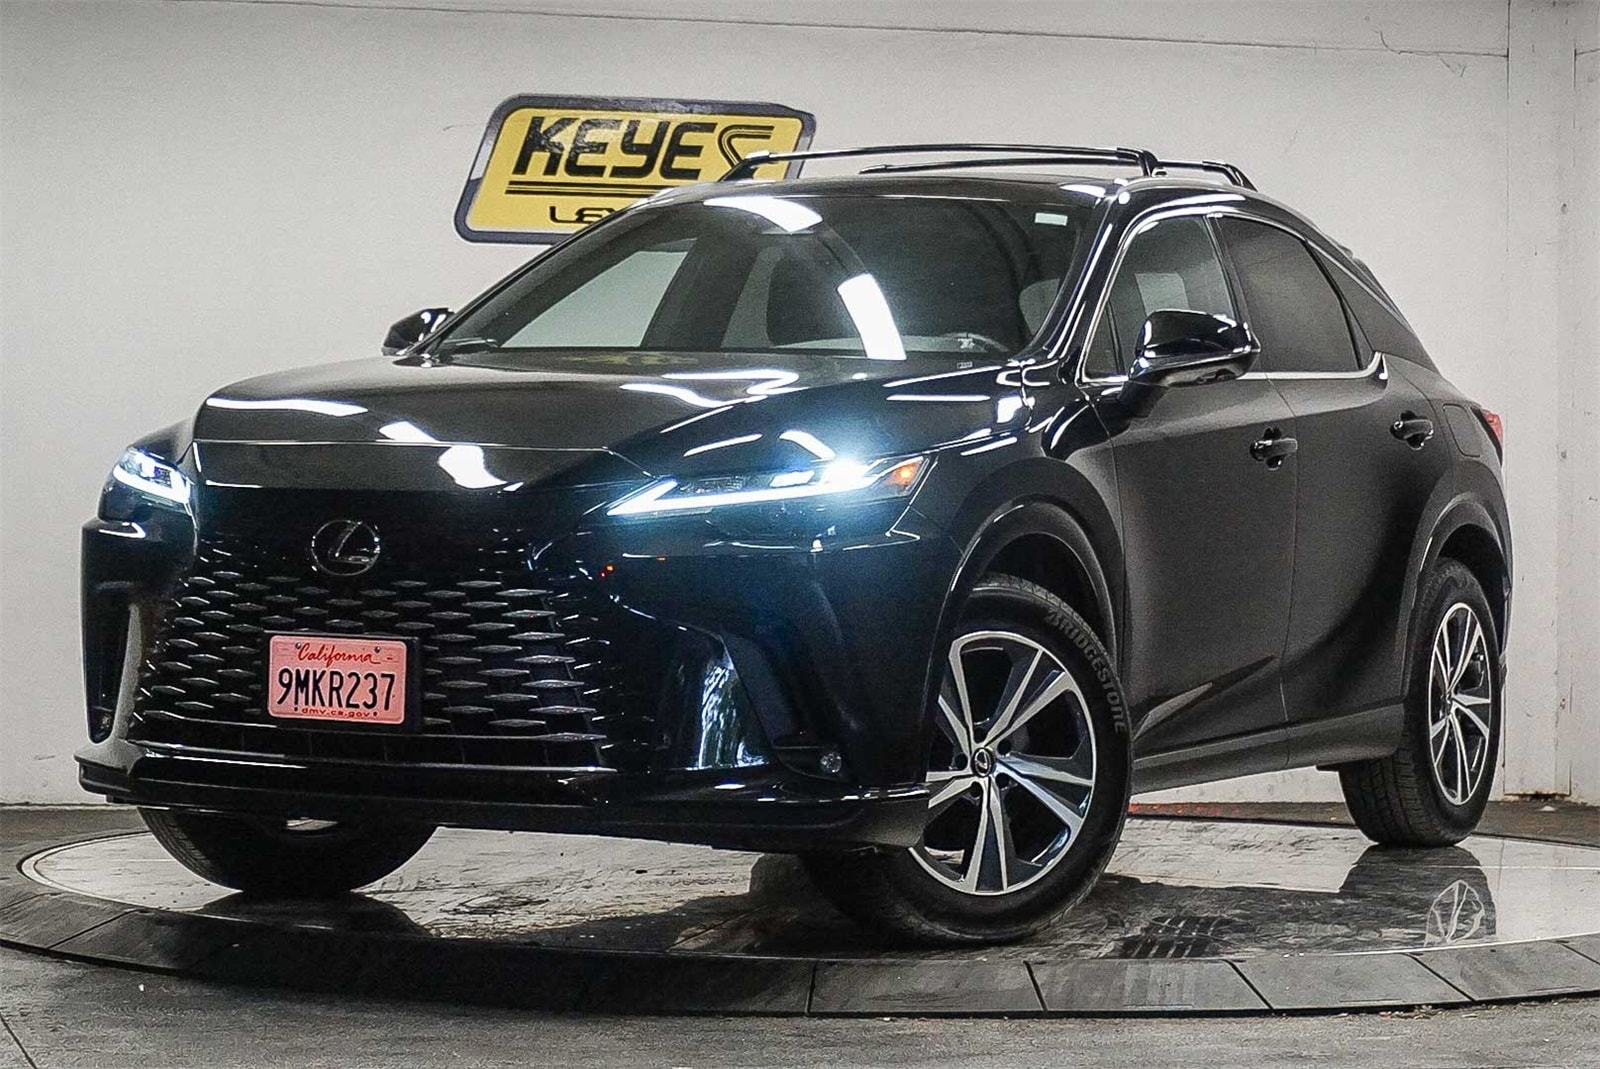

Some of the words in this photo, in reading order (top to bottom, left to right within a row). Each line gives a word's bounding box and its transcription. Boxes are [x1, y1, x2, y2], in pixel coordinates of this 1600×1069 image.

[297, 642, 381, 667] California
[1045, 605, 1127, 734] BRIDGESTONE
[277, 667, 396, 711] 9MKR237
[301, 706, 371, 718] dmv.ca.gov
